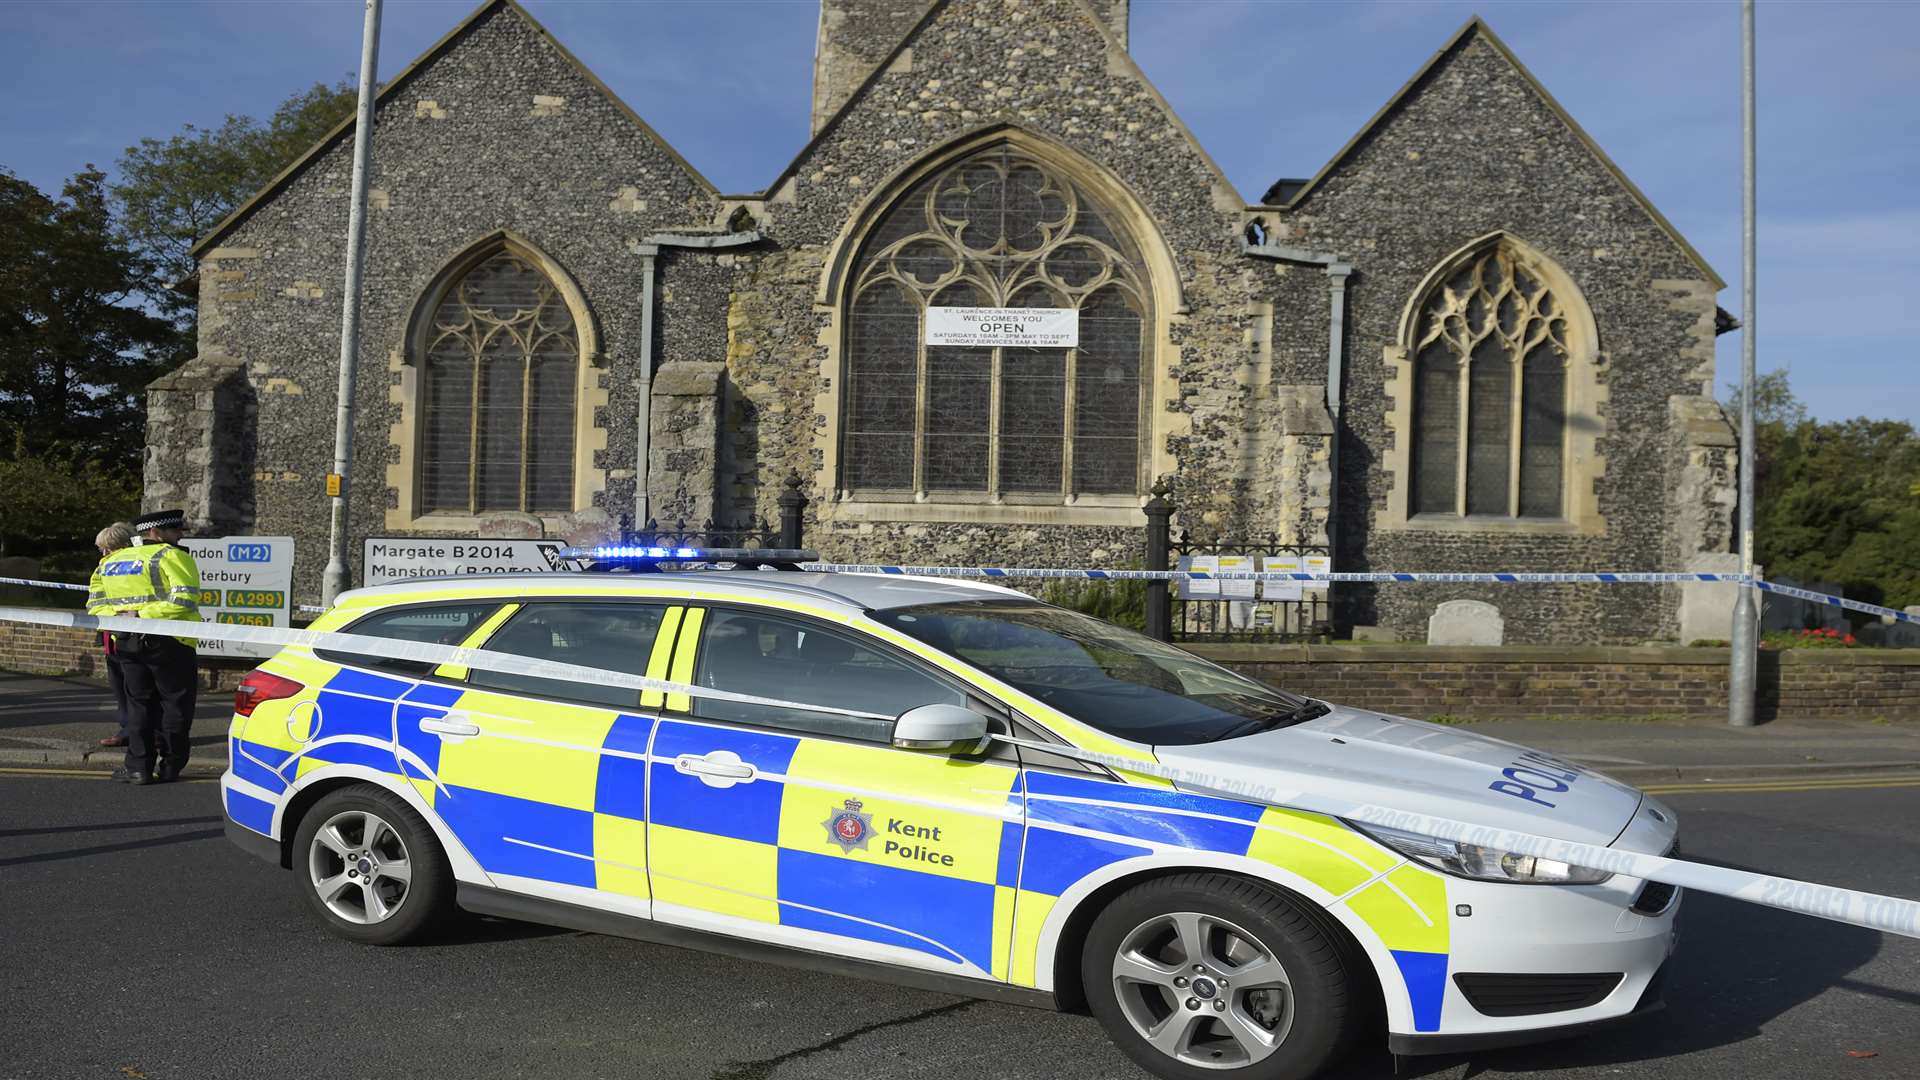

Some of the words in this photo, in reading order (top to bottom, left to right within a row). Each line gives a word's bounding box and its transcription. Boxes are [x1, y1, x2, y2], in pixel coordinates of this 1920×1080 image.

[1022, 315, 1042, 323] YOU
[980, 323, 1025, 333] OPEN
[190, 547, 223, 559] ndon
[372, 545, 445, 560] Margate
[372, 564, 447, 577] Manston
[804, 564, 823, 572] POLICE
[837, 565, 846, 573] DO
[847, 565, 858, 573] NOT
[860, 566, 878, 574] CROSS
[905, 567, 924, 575] POLICE
[926, 567, 939, 575] LINE
[962, 568, 980, 576] CROSS
[1008, 569, 1027, 577] POLICE
[201, 570, 251, 584] terbury
[1111, 571, 1130, 579] POLICE
[1132, 571, 1144, 579] LINE
[1145, 571, 1154, 579] DO
[1213, 572, 1232, 580] POLICE
[1234, 572, 1246, 580] LINE
[1248, 572, 1256, 580] DO
[1316, 573, 1334, 581] POLICE
[1336, 573, 1349, 581] LINE
[1350, 573, 1359, 581] DO
[1360, 573, 1371, 581] NOT
[1372, 573, 1390, 581] CROSS
[887, 818, 942, 841] Kent
[884, 840, 955, 867] Police
